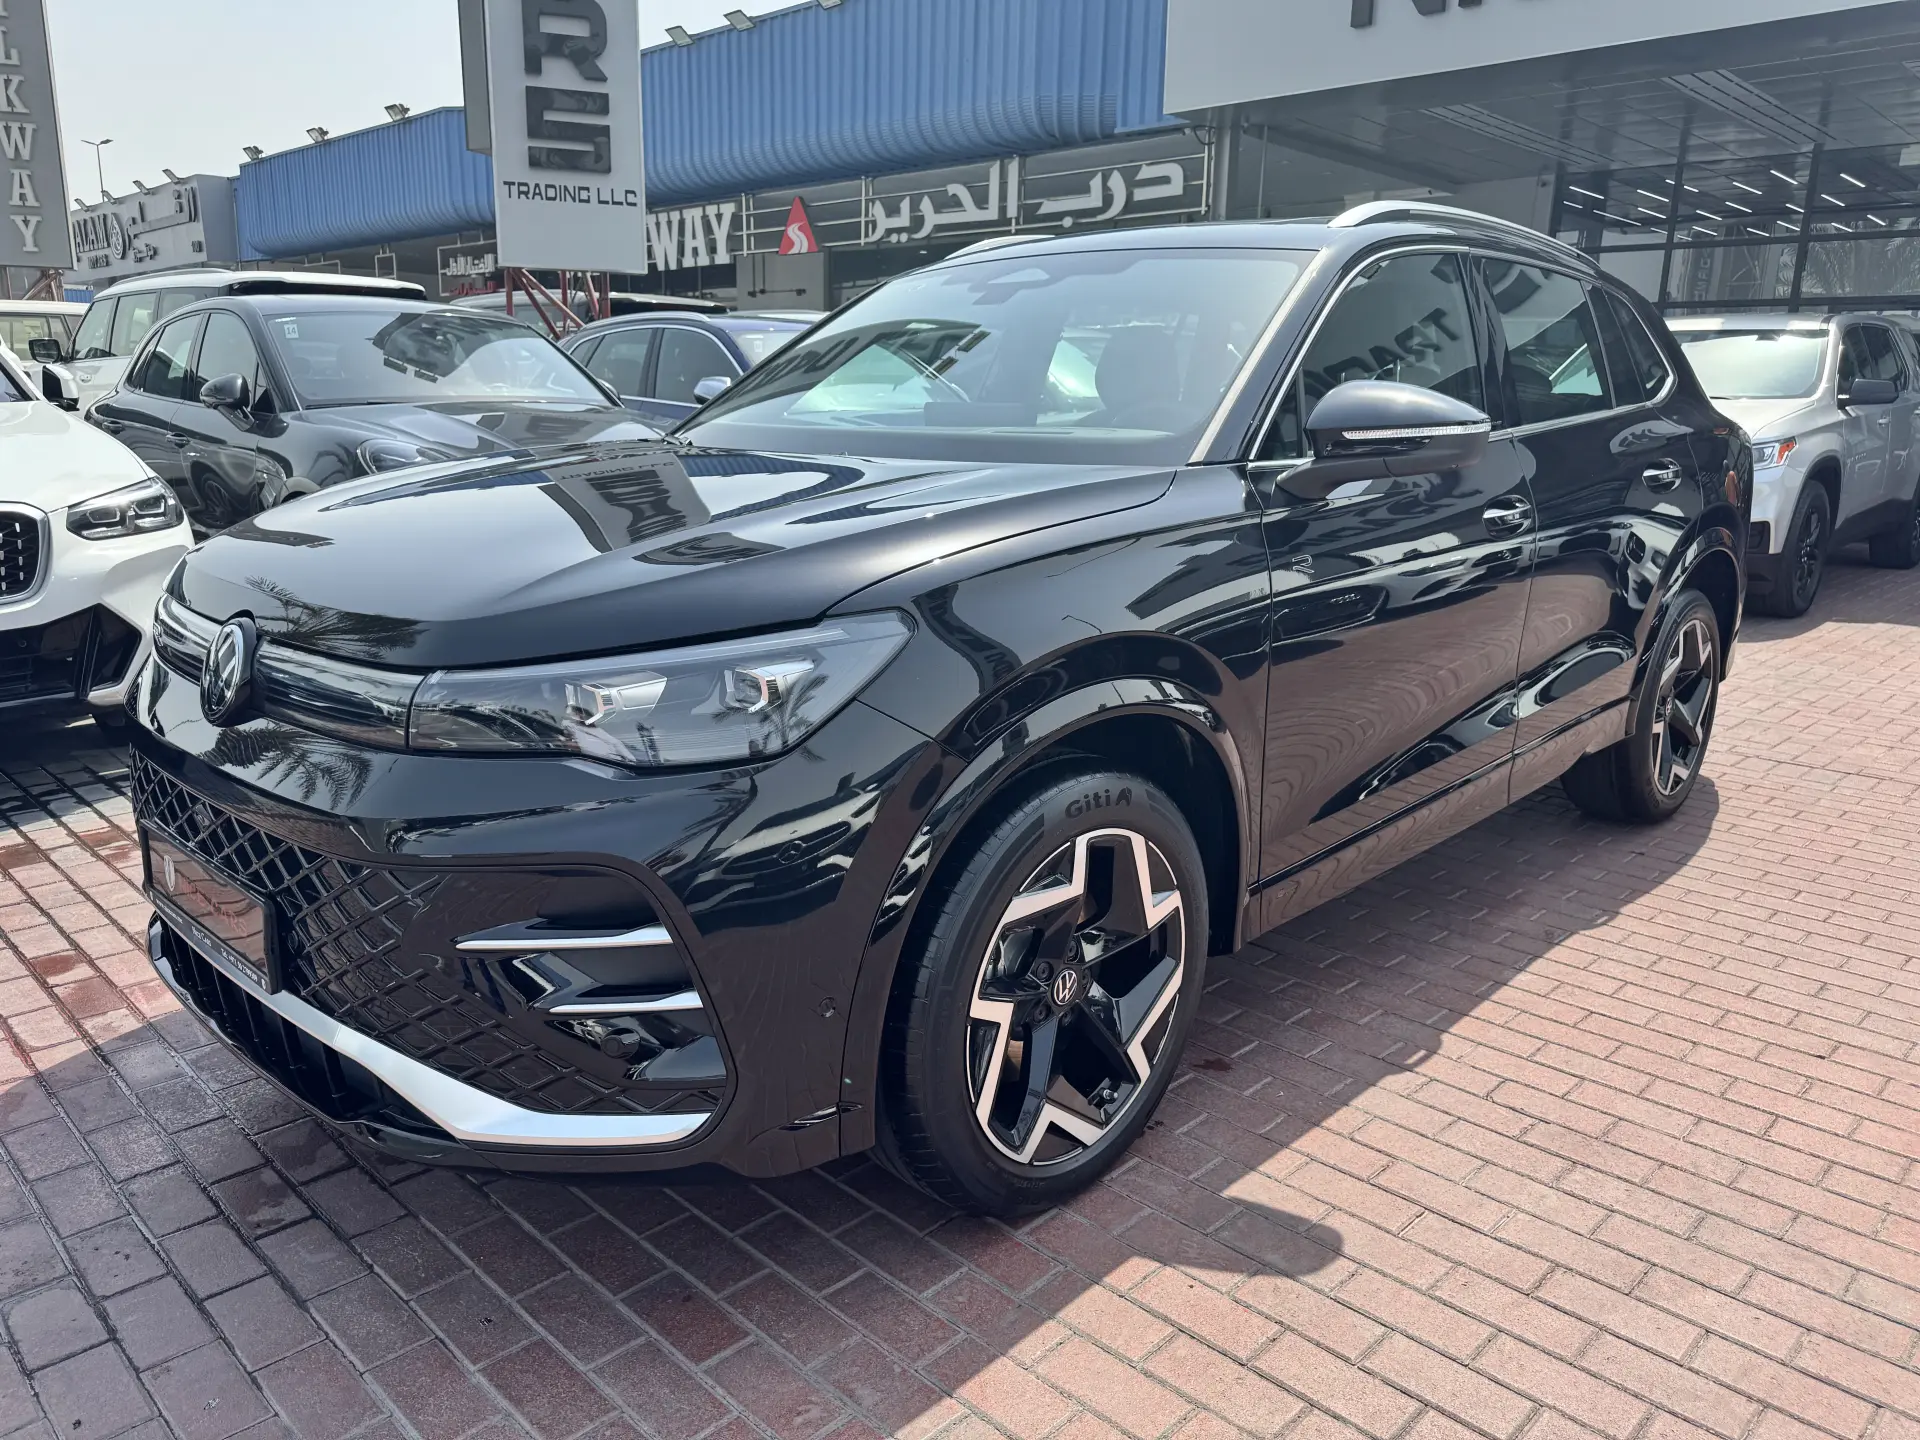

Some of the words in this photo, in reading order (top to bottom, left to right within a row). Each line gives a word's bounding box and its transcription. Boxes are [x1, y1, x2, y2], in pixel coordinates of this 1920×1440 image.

[503, 180, 591, 204] TRADING
[597, 187, 638, 207] LLC
[864, 158, 1019, 243] الحرير
[1036, 162, 1184, 228] درب
